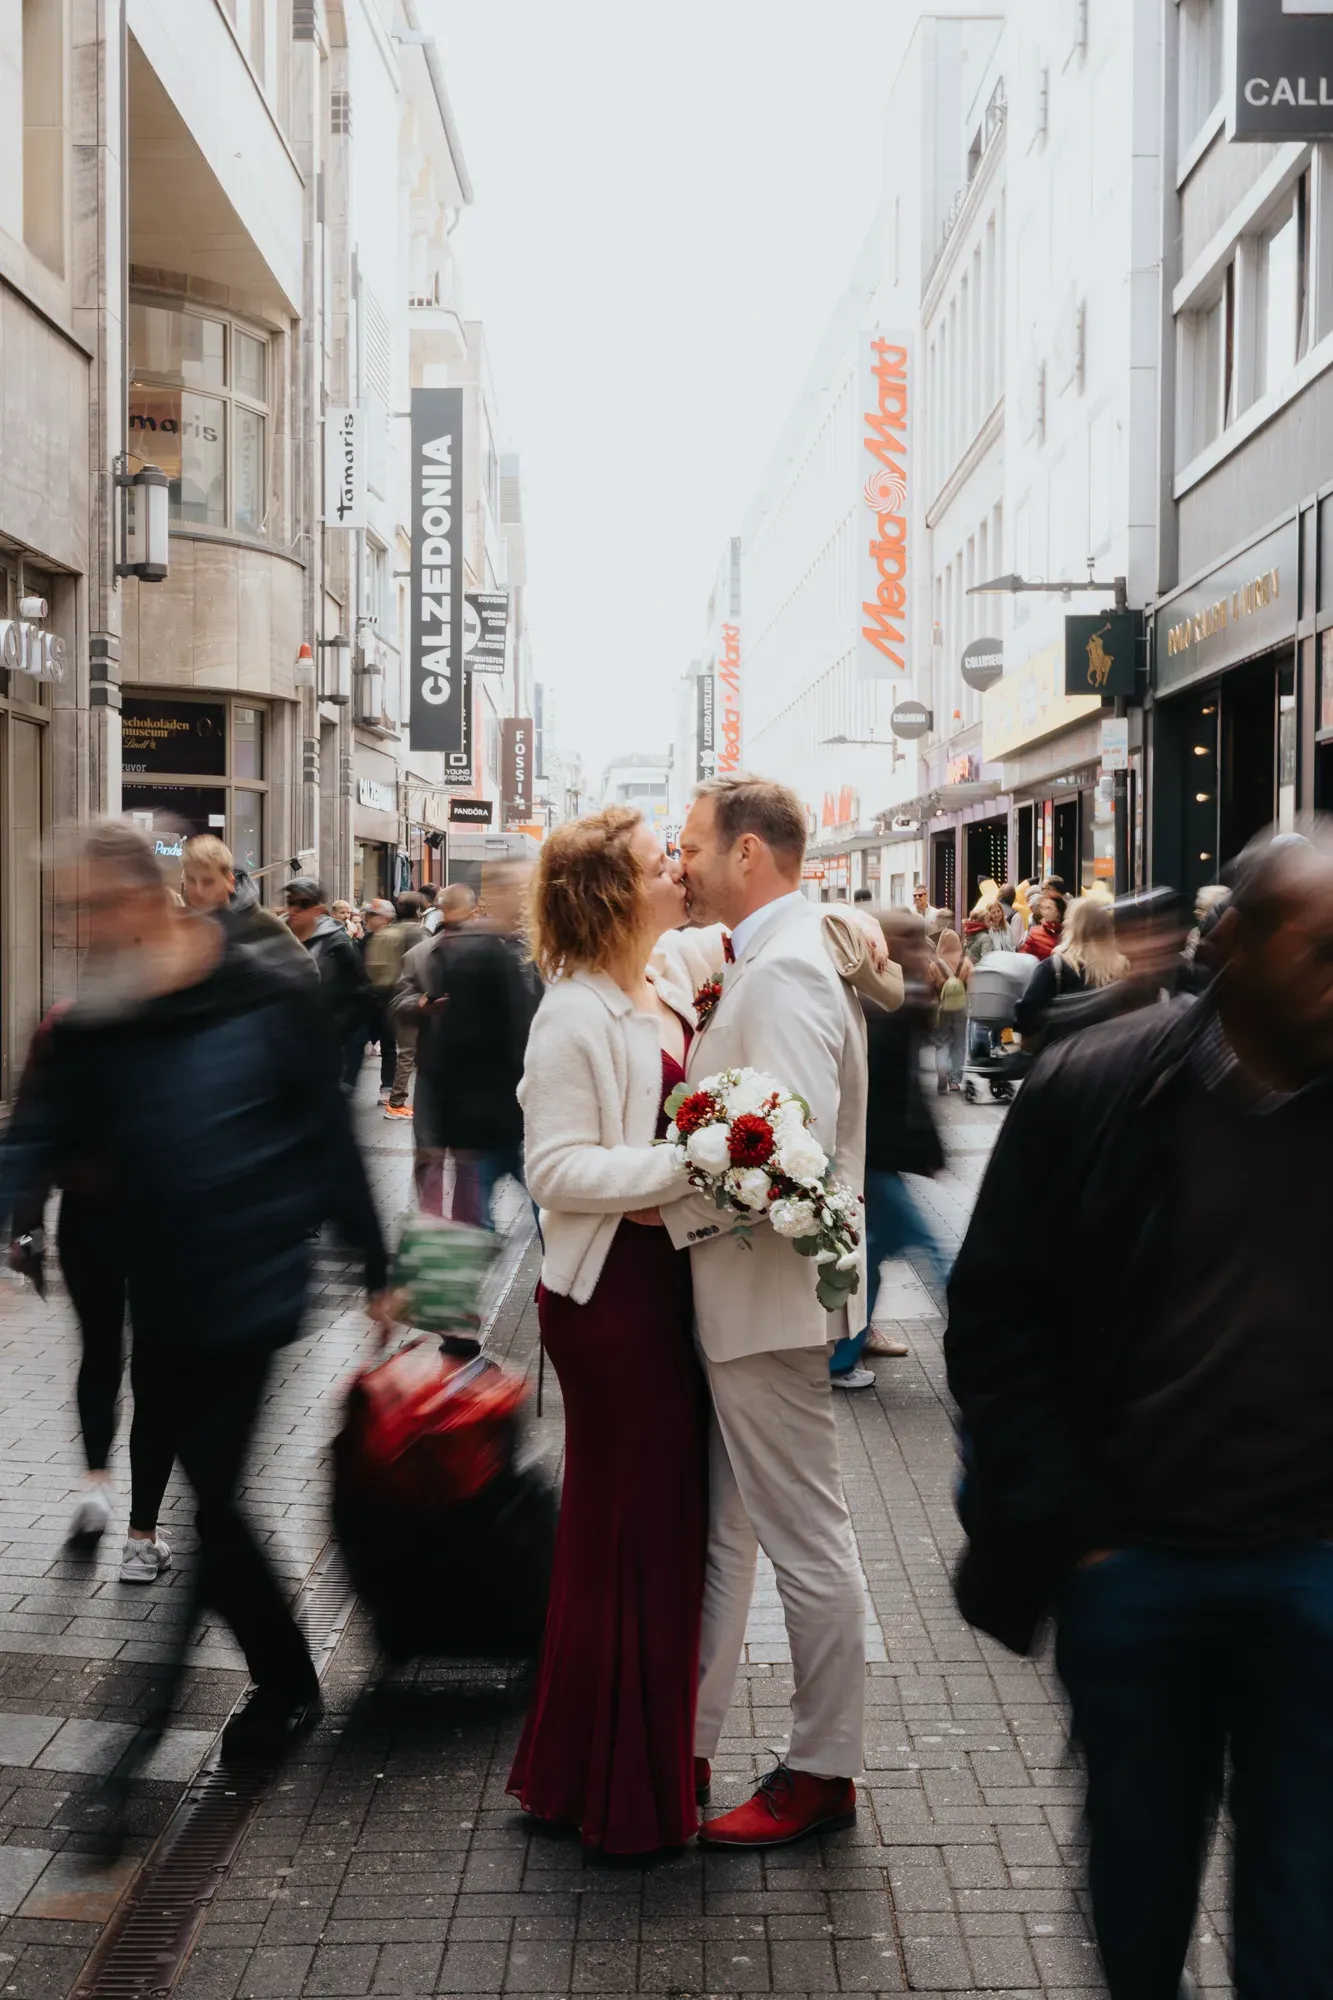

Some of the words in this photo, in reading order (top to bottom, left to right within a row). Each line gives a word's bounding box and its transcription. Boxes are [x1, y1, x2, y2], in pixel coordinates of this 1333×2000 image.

[1244, 76, 1333, 106] CALL
[864, 336, 908, 482] Markt
[421, 433, 452, 706] CALZEDONIA
[862, 512, 907, 670] Media
